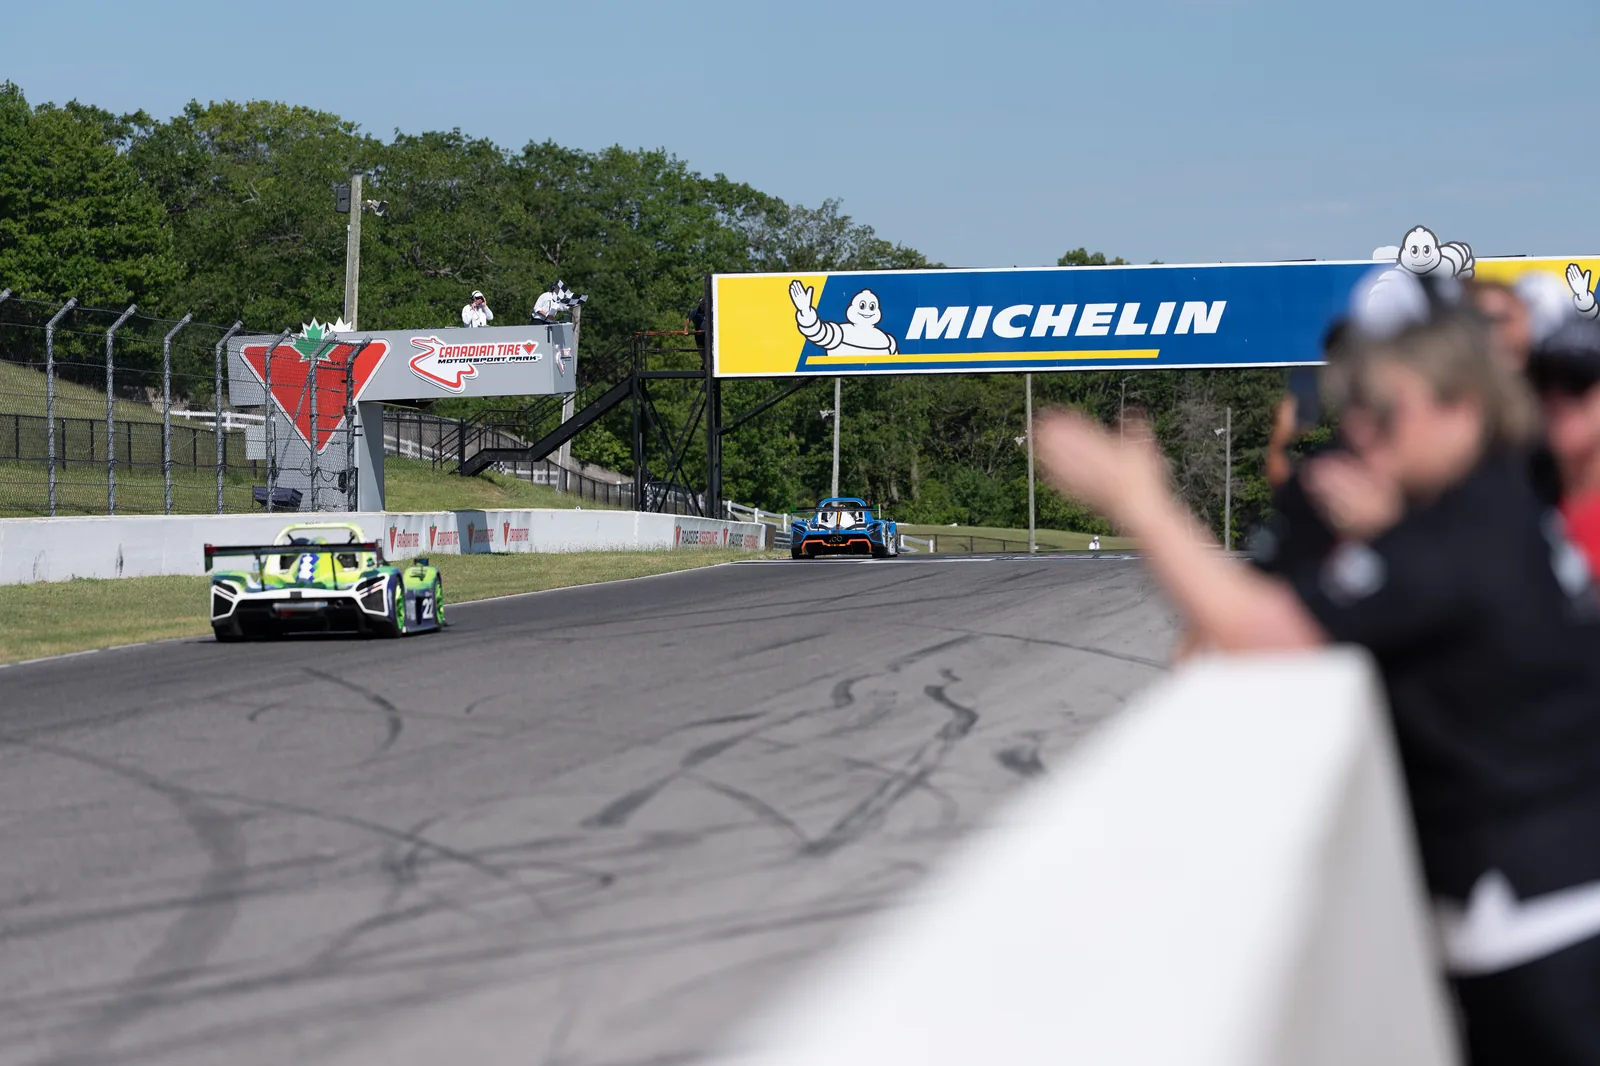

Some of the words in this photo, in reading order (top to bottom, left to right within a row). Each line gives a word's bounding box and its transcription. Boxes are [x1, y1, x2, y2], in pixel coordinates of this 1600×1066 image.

[905, 300, 1227, 340] MICHELIN
[439, 345, 495, 358] CANADIAN
[498, 344, 520, 355] TIRE
